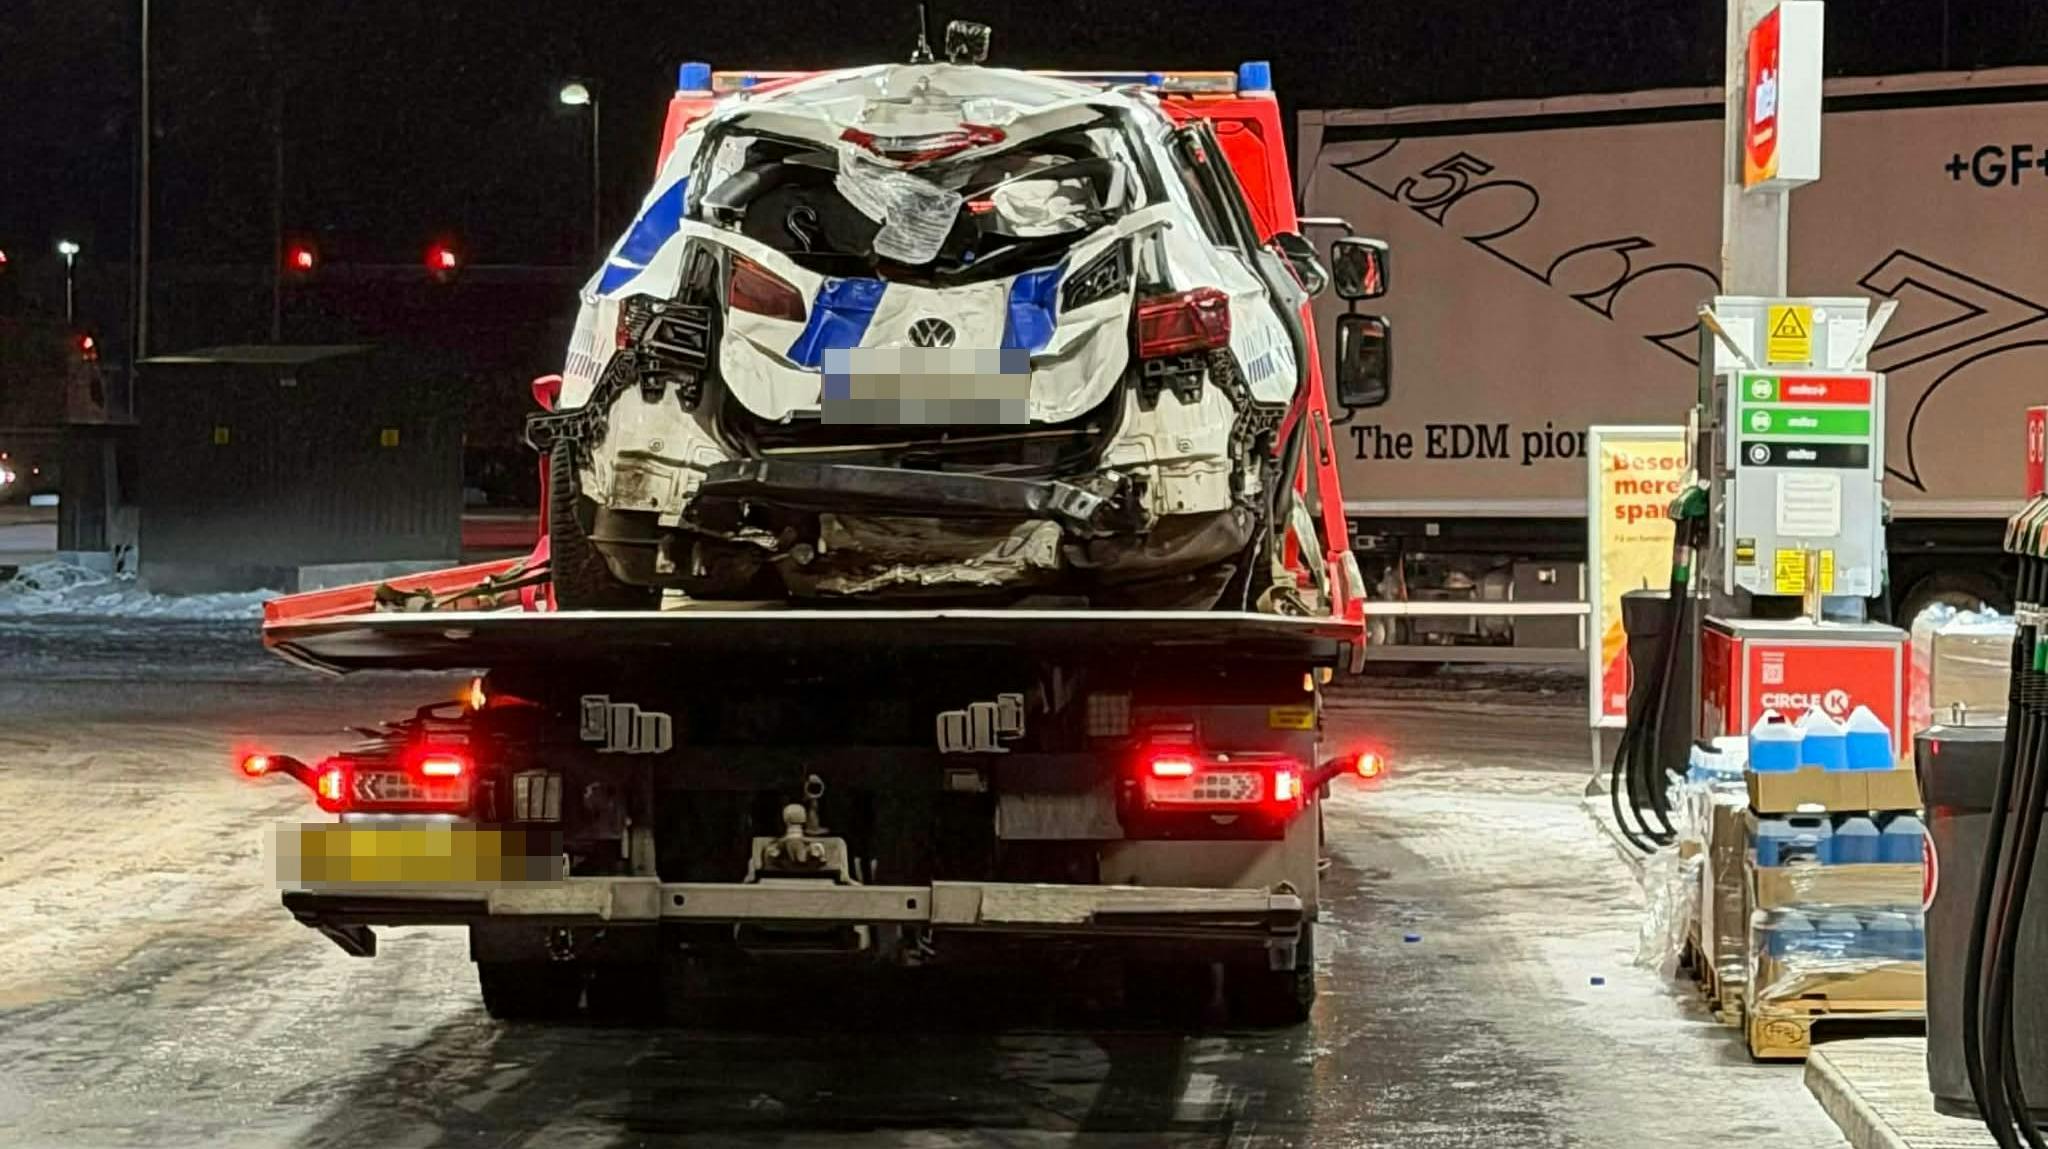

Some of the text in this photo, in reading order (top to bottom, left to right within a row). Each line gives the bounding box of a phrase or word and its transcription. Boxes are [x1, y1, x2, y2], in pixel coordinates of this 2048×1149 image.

[1350, 425, 1413, 459] The
[1425, 424, 1512, 459] EDM
[1760, 690, 1848, 714] CIRCLE K
